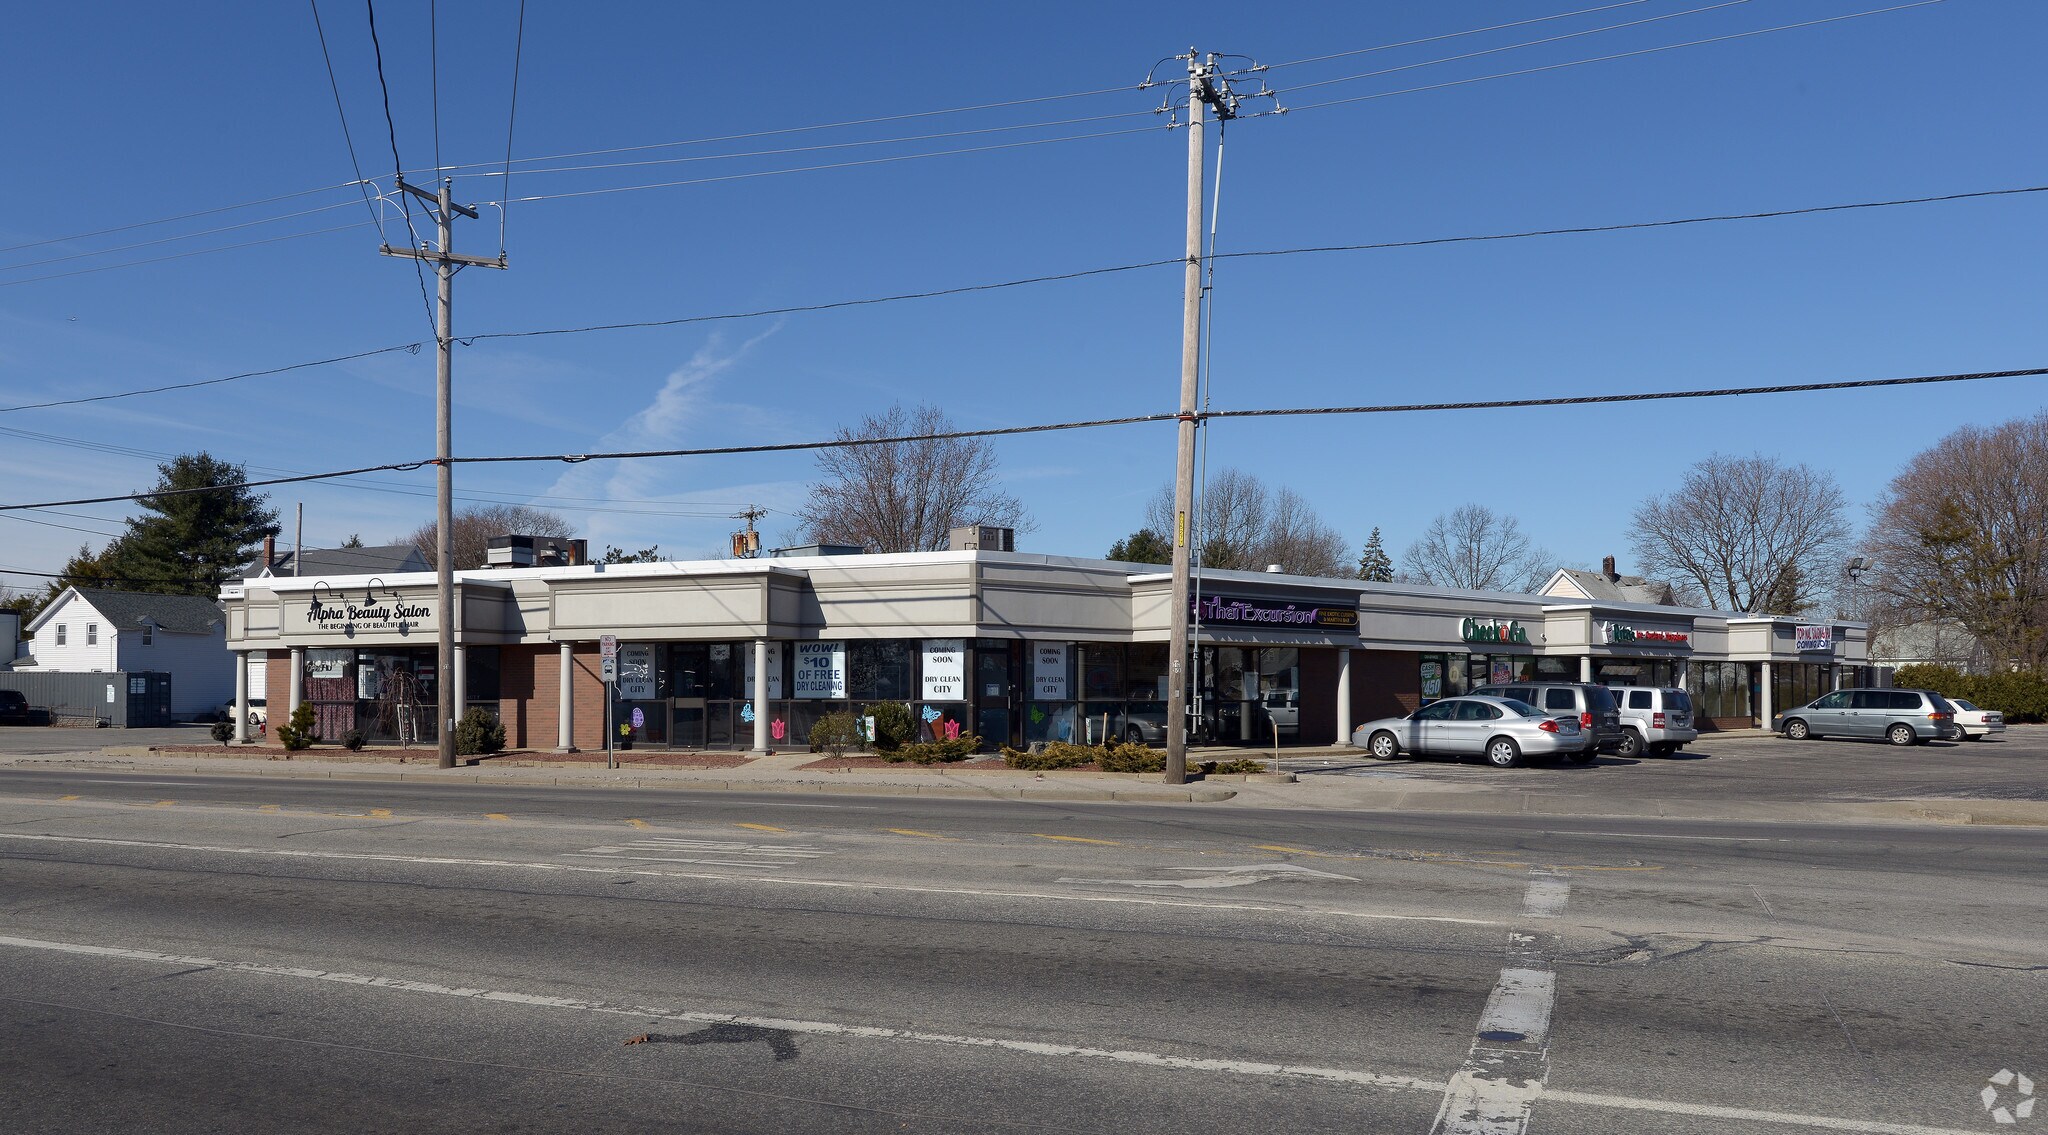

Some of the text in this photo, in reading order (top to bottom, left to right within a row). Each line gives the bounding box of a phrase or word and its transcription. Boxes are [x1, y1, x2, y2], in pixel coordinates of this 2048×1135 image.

[307, 604, 431, 623] Alpha Beauty Salon
[1240, 602, 1318, 624] Excursion
[1459, 617, 1501, 642] Check
[1508, 620, 1526, 643] Go
[800, 643, 839, 653] WOW!
[803, 657, 830, 668] $10
[932, 656, 953, 664] SOON
[798, 669, 841, 680] OF FREE
[796, 681, 843, 691] DRY CLEANING
